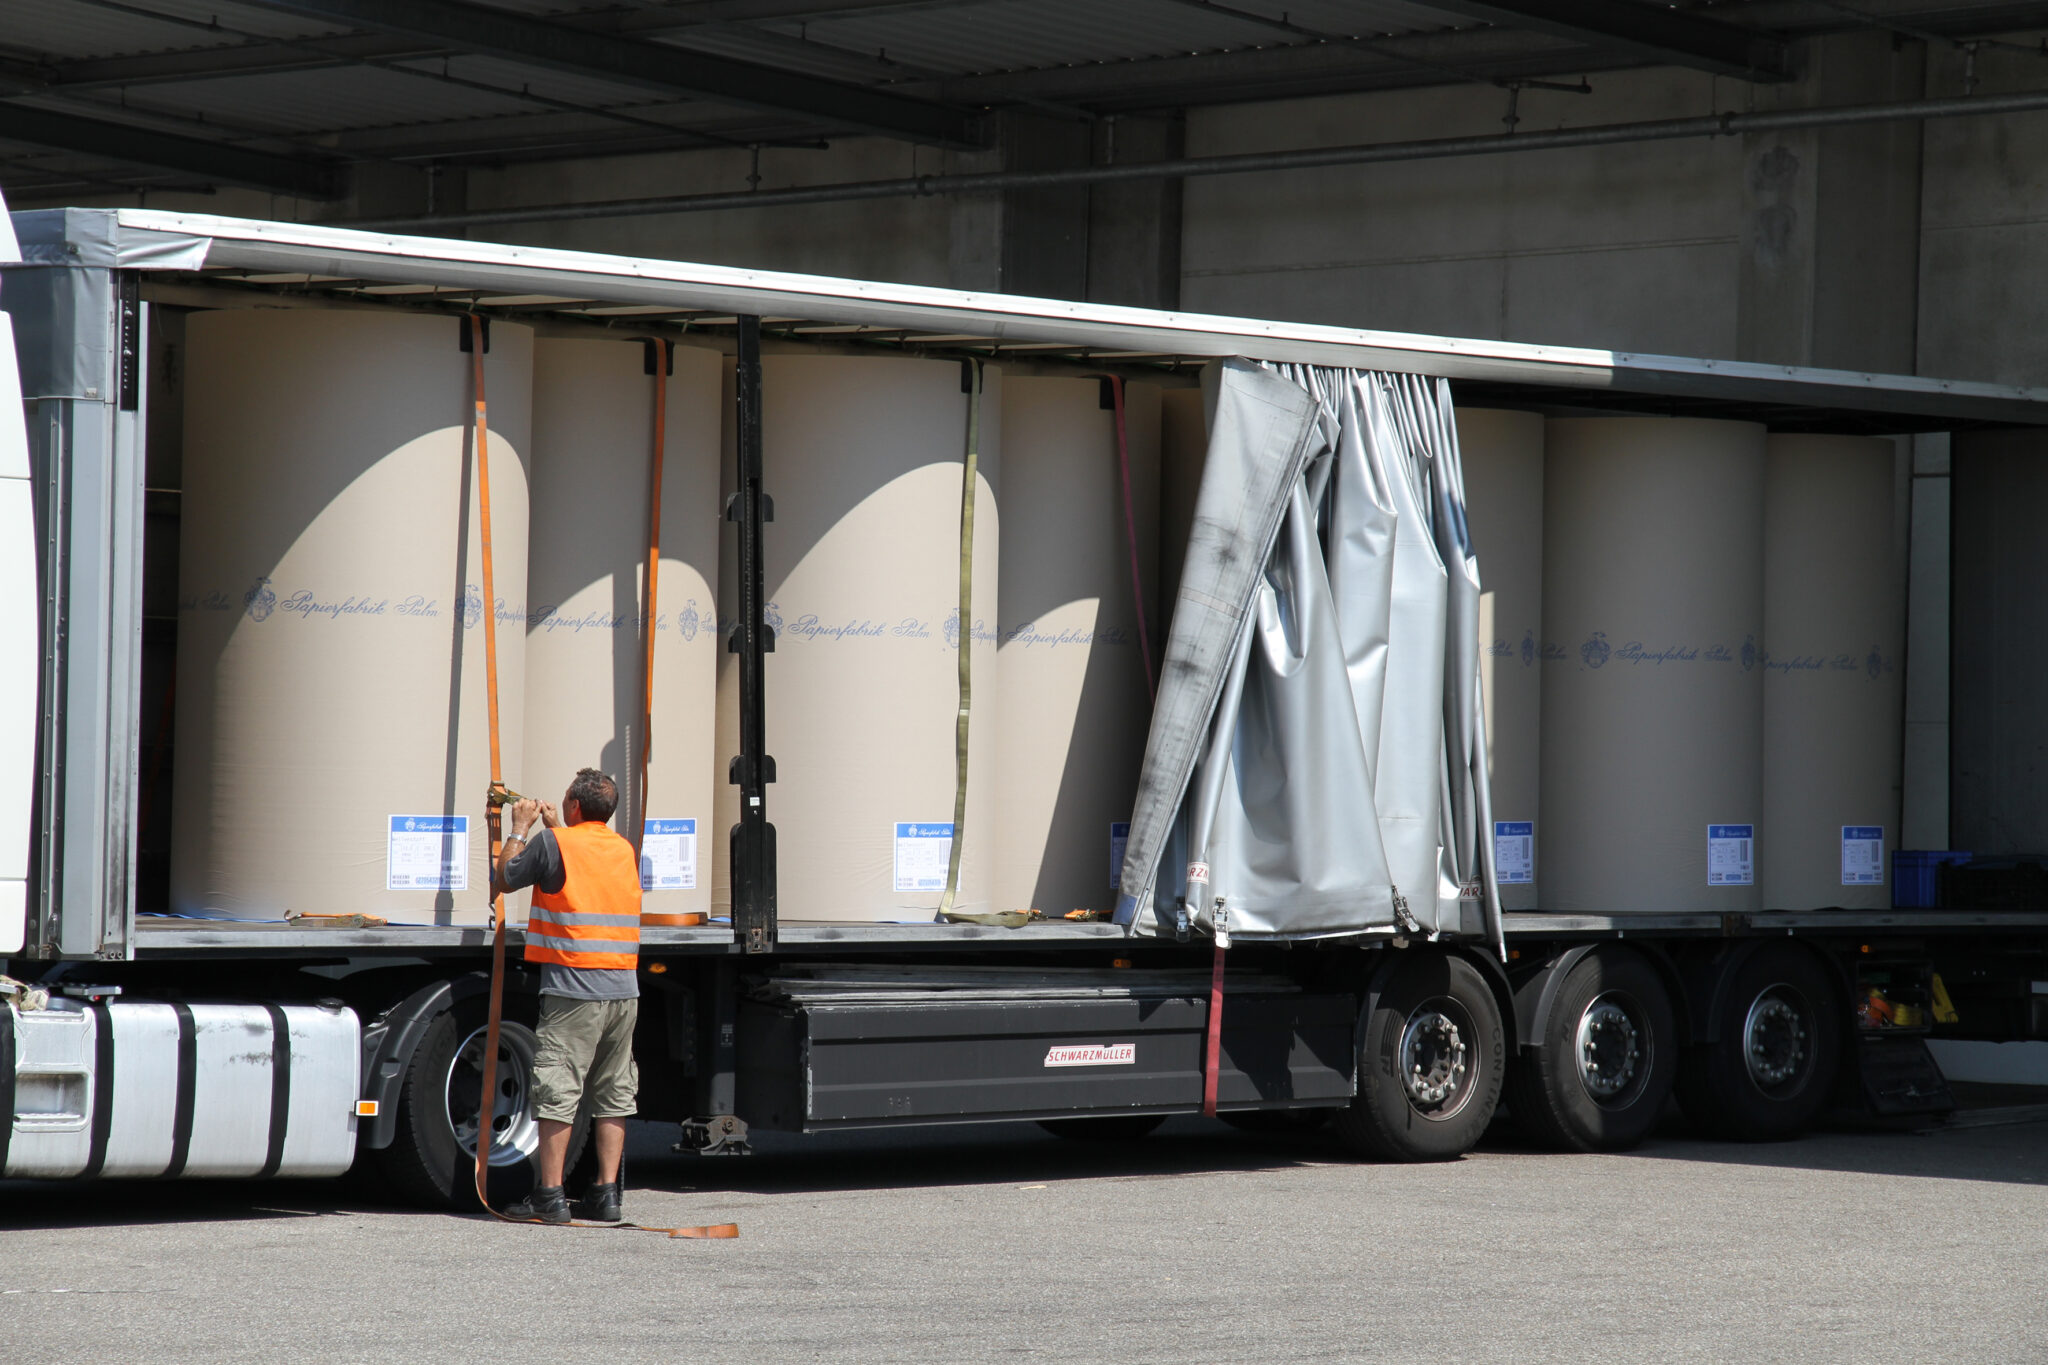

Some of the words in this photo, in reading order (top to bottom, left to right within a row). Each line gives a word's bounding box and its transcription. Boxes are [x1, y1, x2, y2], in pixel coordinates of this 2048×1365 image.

[280, 590, 386, 619] Papierfabrik
[394, 595, 440, 617] Palm
[526, 605, 625, 632] Papierfabrik
[788, 614, 886, 640] Papierfabrik
[892, 617, 932, 639] Palm
[1005, 623, 1095, 648] Papierfabrik
[1615, 641, 1699, 665] Papierfabrik
[1048, 1048, 1132, 1062] SCHWARZMÜLLER
